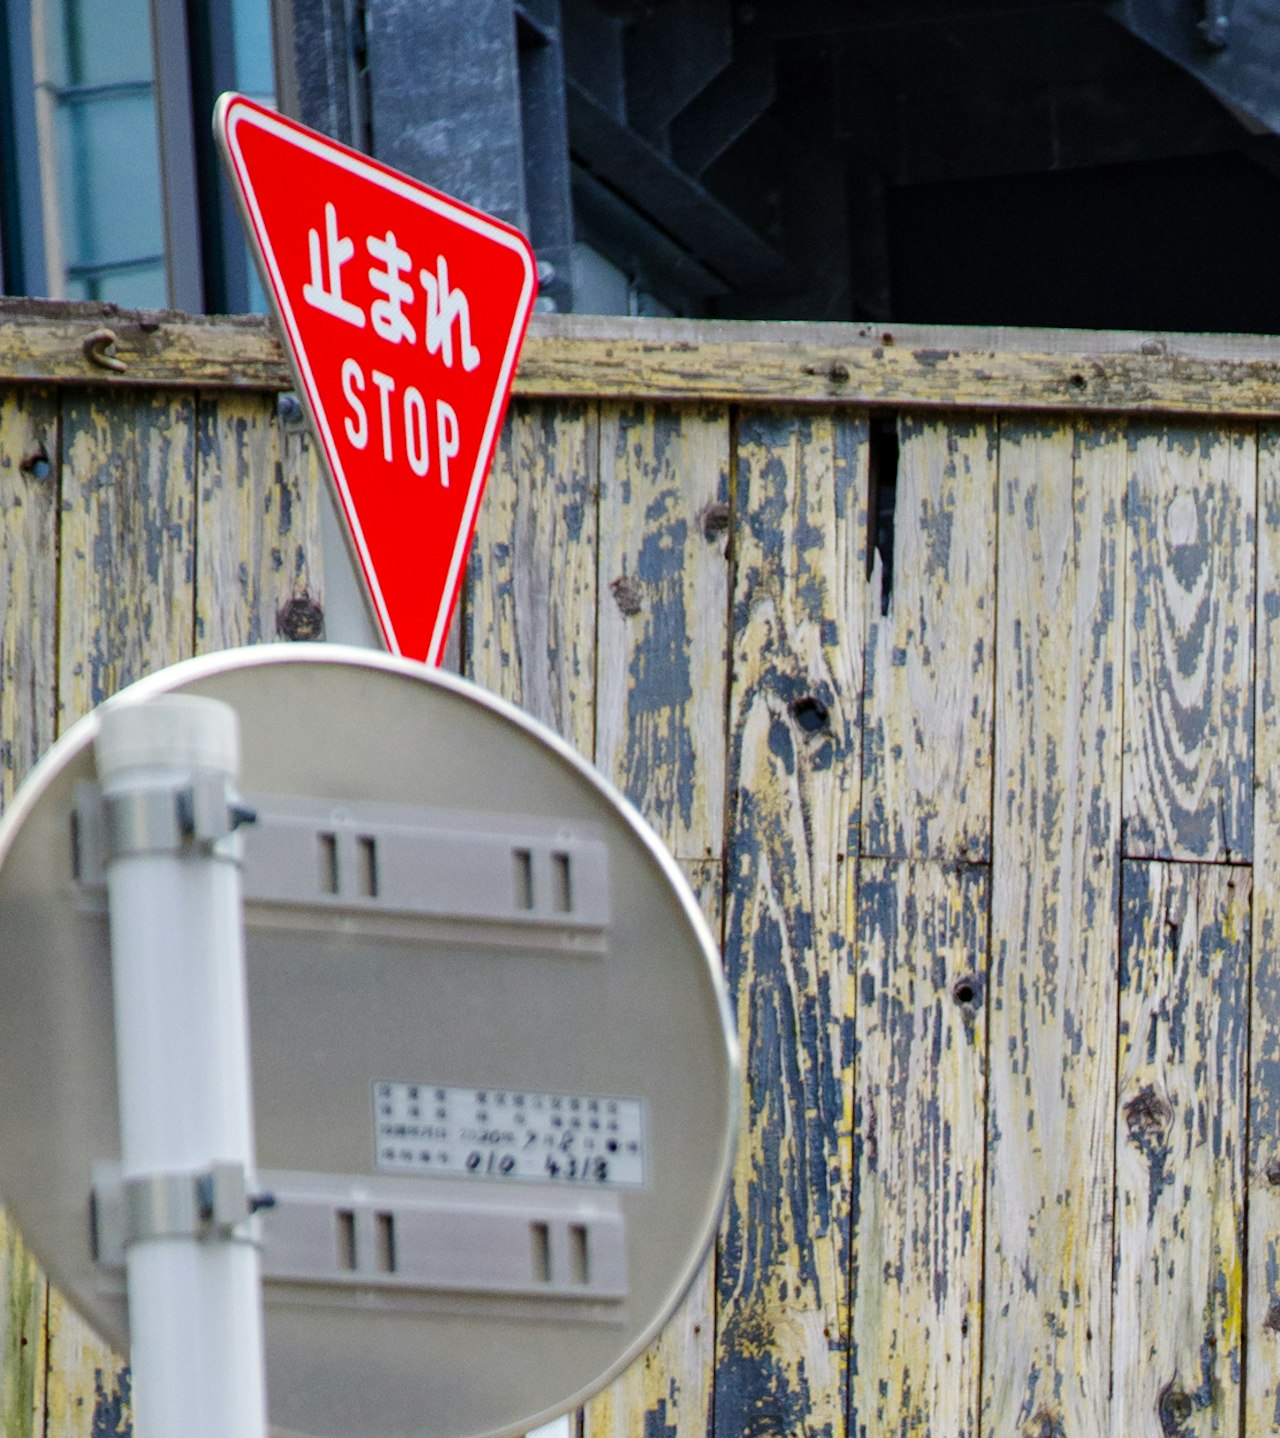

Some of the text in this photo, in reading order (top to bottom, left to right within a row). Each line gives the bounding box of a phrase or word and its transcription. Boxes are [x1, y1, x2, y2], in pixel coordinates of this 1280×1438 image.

[303, 201, 481, 372] 止まれ
[341, 357, 461, 488] STOP
